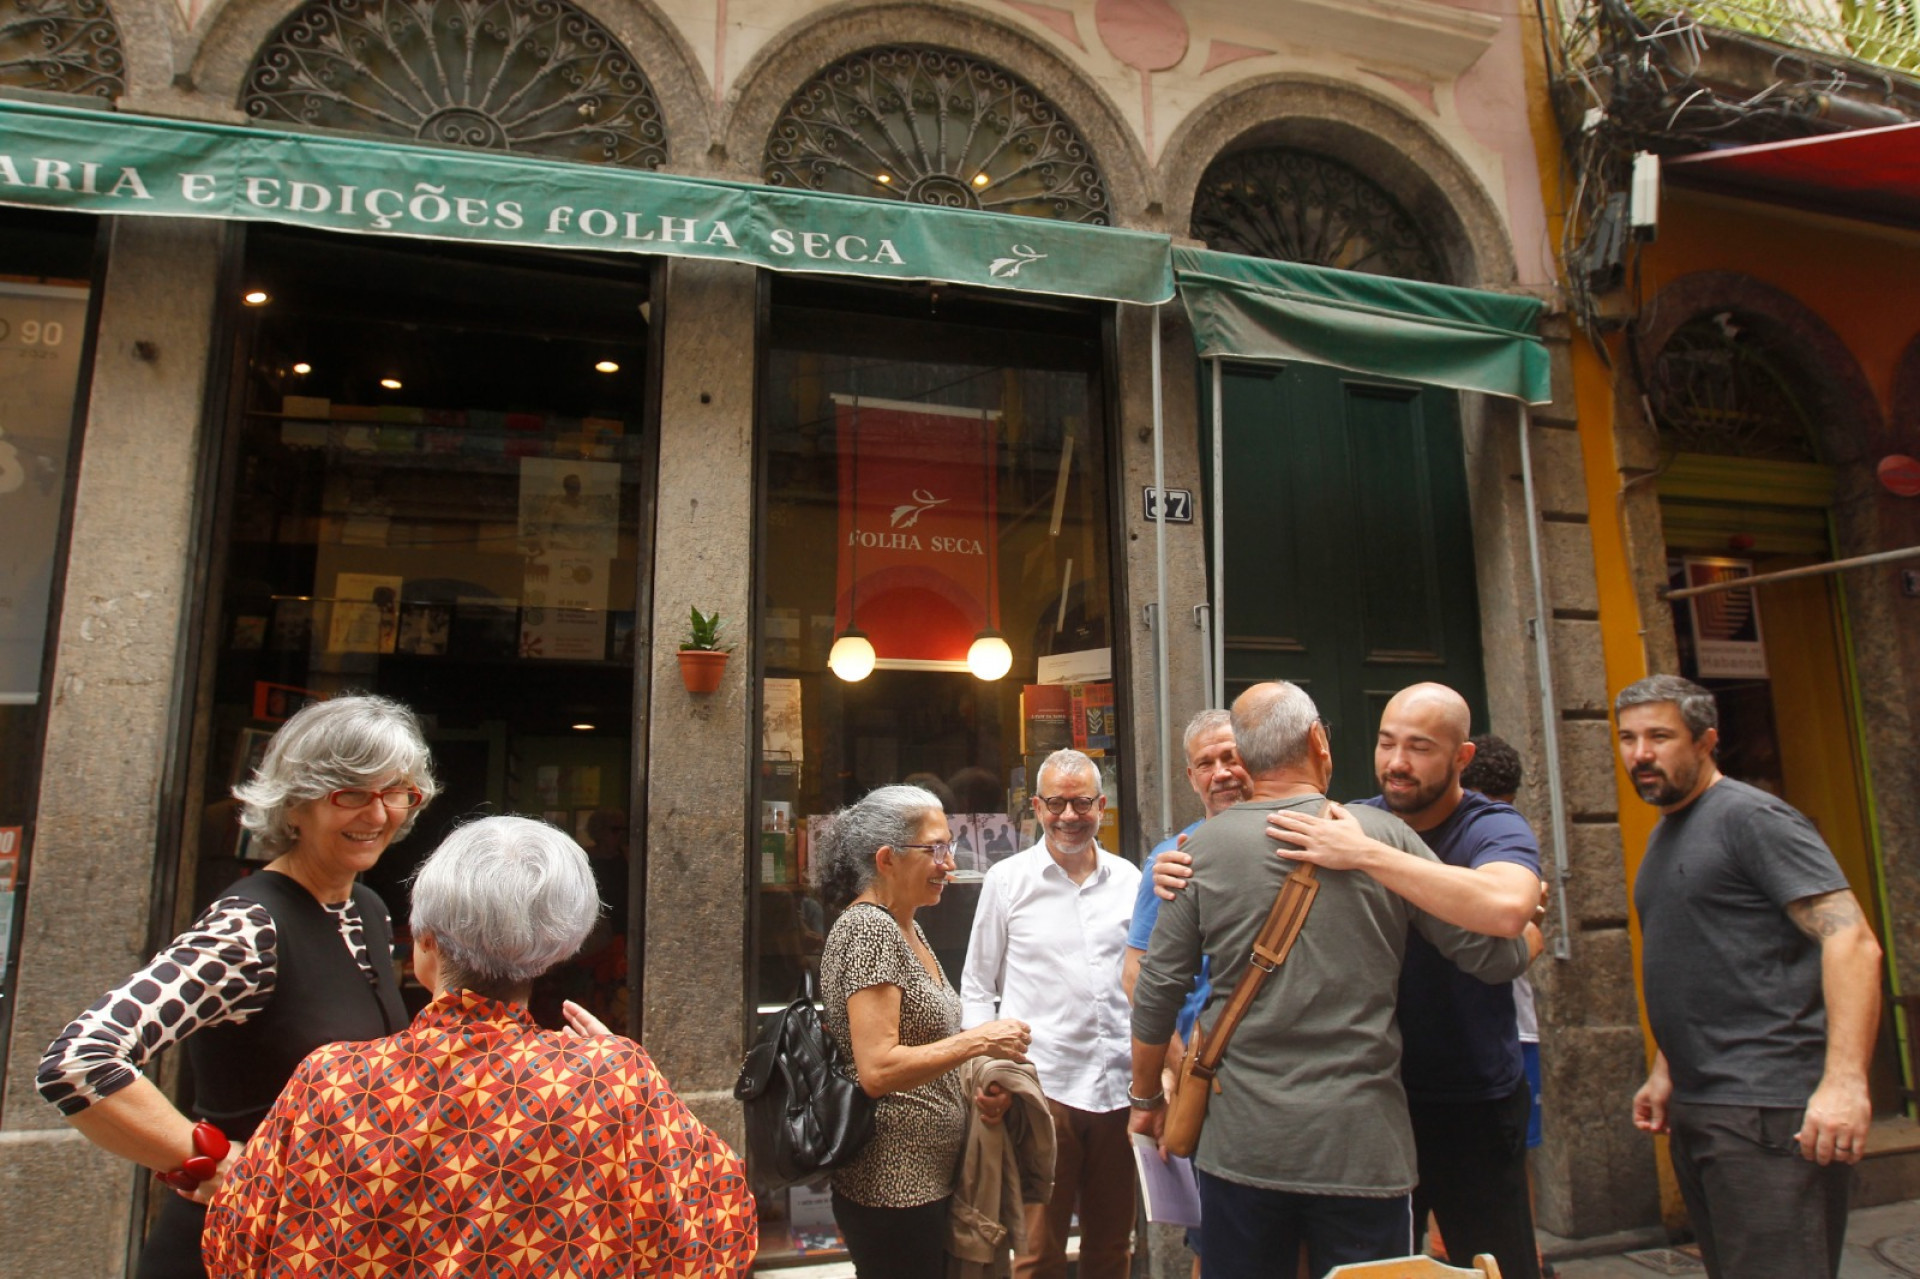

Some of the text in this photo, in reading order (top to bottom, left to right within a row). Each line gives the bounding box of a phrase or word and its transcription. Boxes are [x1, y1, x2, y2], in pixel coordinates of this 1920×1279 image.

[178, 173, 217, 202] E
[246, 176, 523, 230] EDIÇÕES
[545, 206, 740, 248] FOLHA
[769, 228, 906, 265] SECA
[21, 320, 63, 346] 90
[931, 535, 984, 555] SECA
